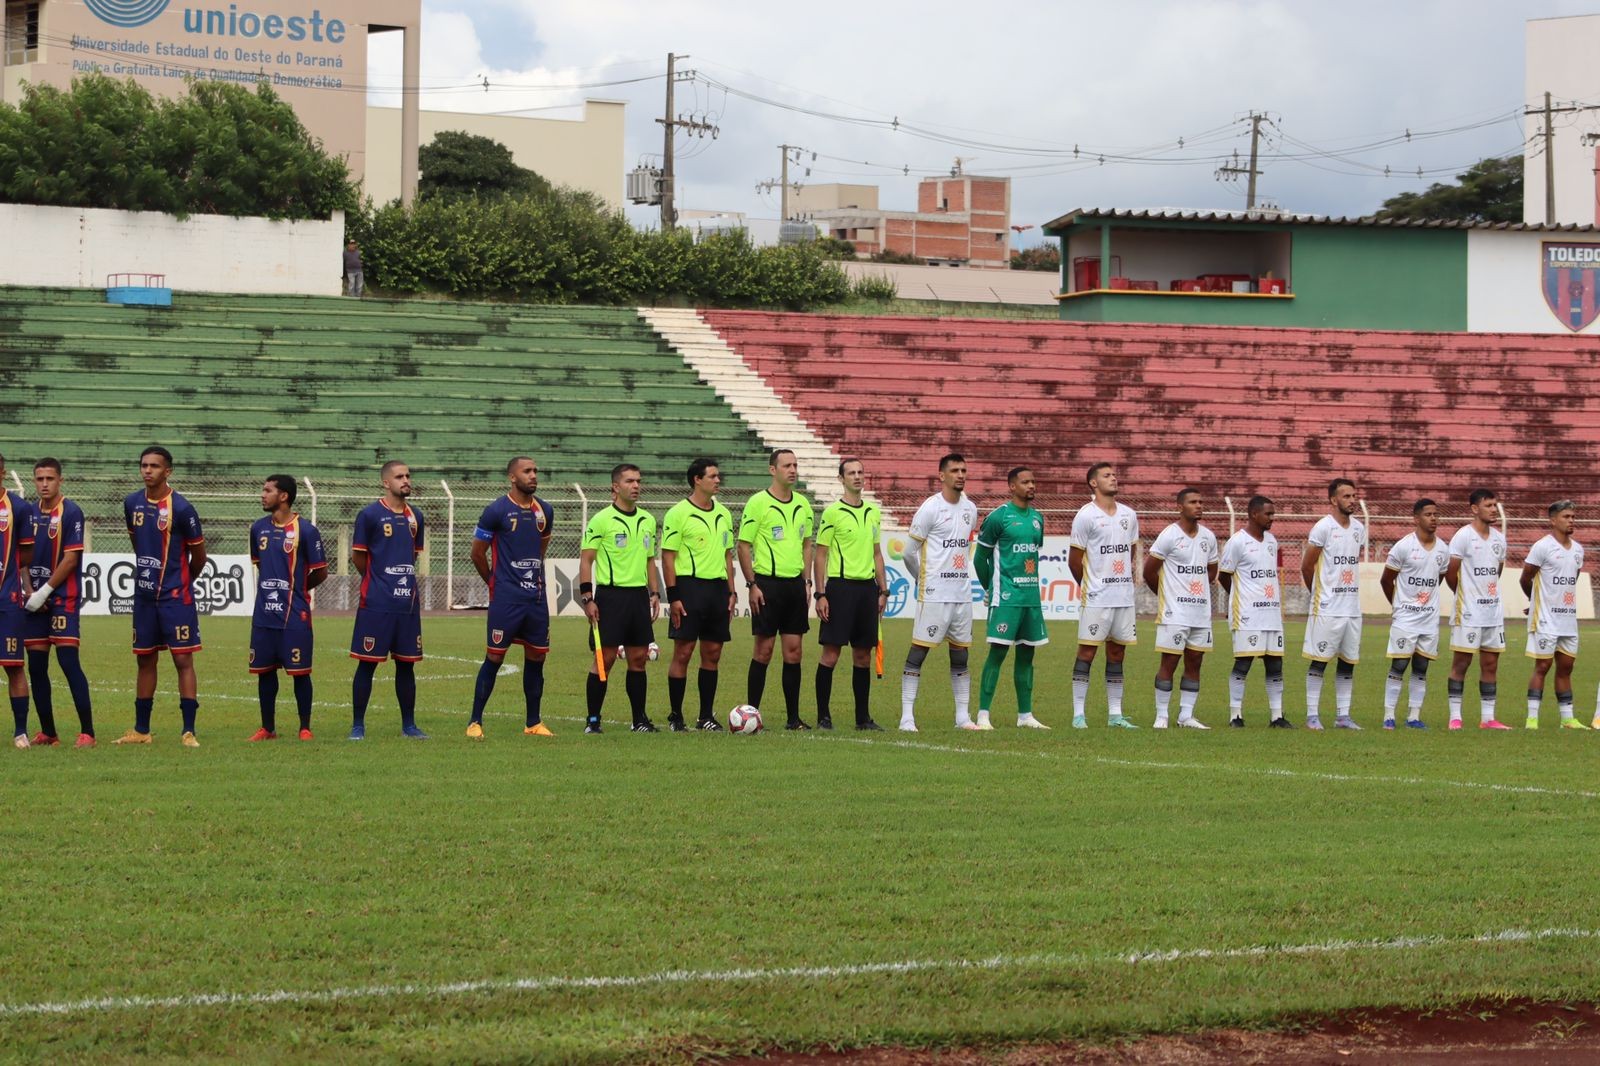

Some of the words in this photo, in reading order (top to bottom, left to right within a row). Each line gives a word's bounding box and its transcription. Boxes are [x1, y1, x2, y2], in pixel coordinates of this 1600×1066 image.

[184, 4, 346, 43] unioeste
[72, 34, 150, 54] Universidade
[156, 42, 209, 59] Estadual
[214, 47, 229, 60] do
[235, 48, 272, 63] Oeste
[277, 51, 291, 65] do
[296, 52, 343, 68] Paraná
[113, 62, 160, 77] Gratuita
[163, 64, 192, 79] Laica
[194, 68, 206, 80] de
[274, 72, 343, 88] Democrática
[1548, 247, 1600, 262] TOLEDO
[133, 512, 144, 526] 13
[510, 518, 518, 532] 7
[383, 523, 393, 537] 9
[259, 536, 268, 550] 3
[1100, 544, 1130, 555] DENBA
[1552, 577, 1576, 585] DENB
[193, 577, 240, 607] sign
[393, 588, 411, 596] AZPEC
[265, 602, 284, 611] AZPEC
[52, 615, 66, 630] 20
[175, 626, 190, 641] 13
[6, 637, 18, 652] 19
[1277, 635, 1283, 648] 8
[291, 648, 301, 662] 3
